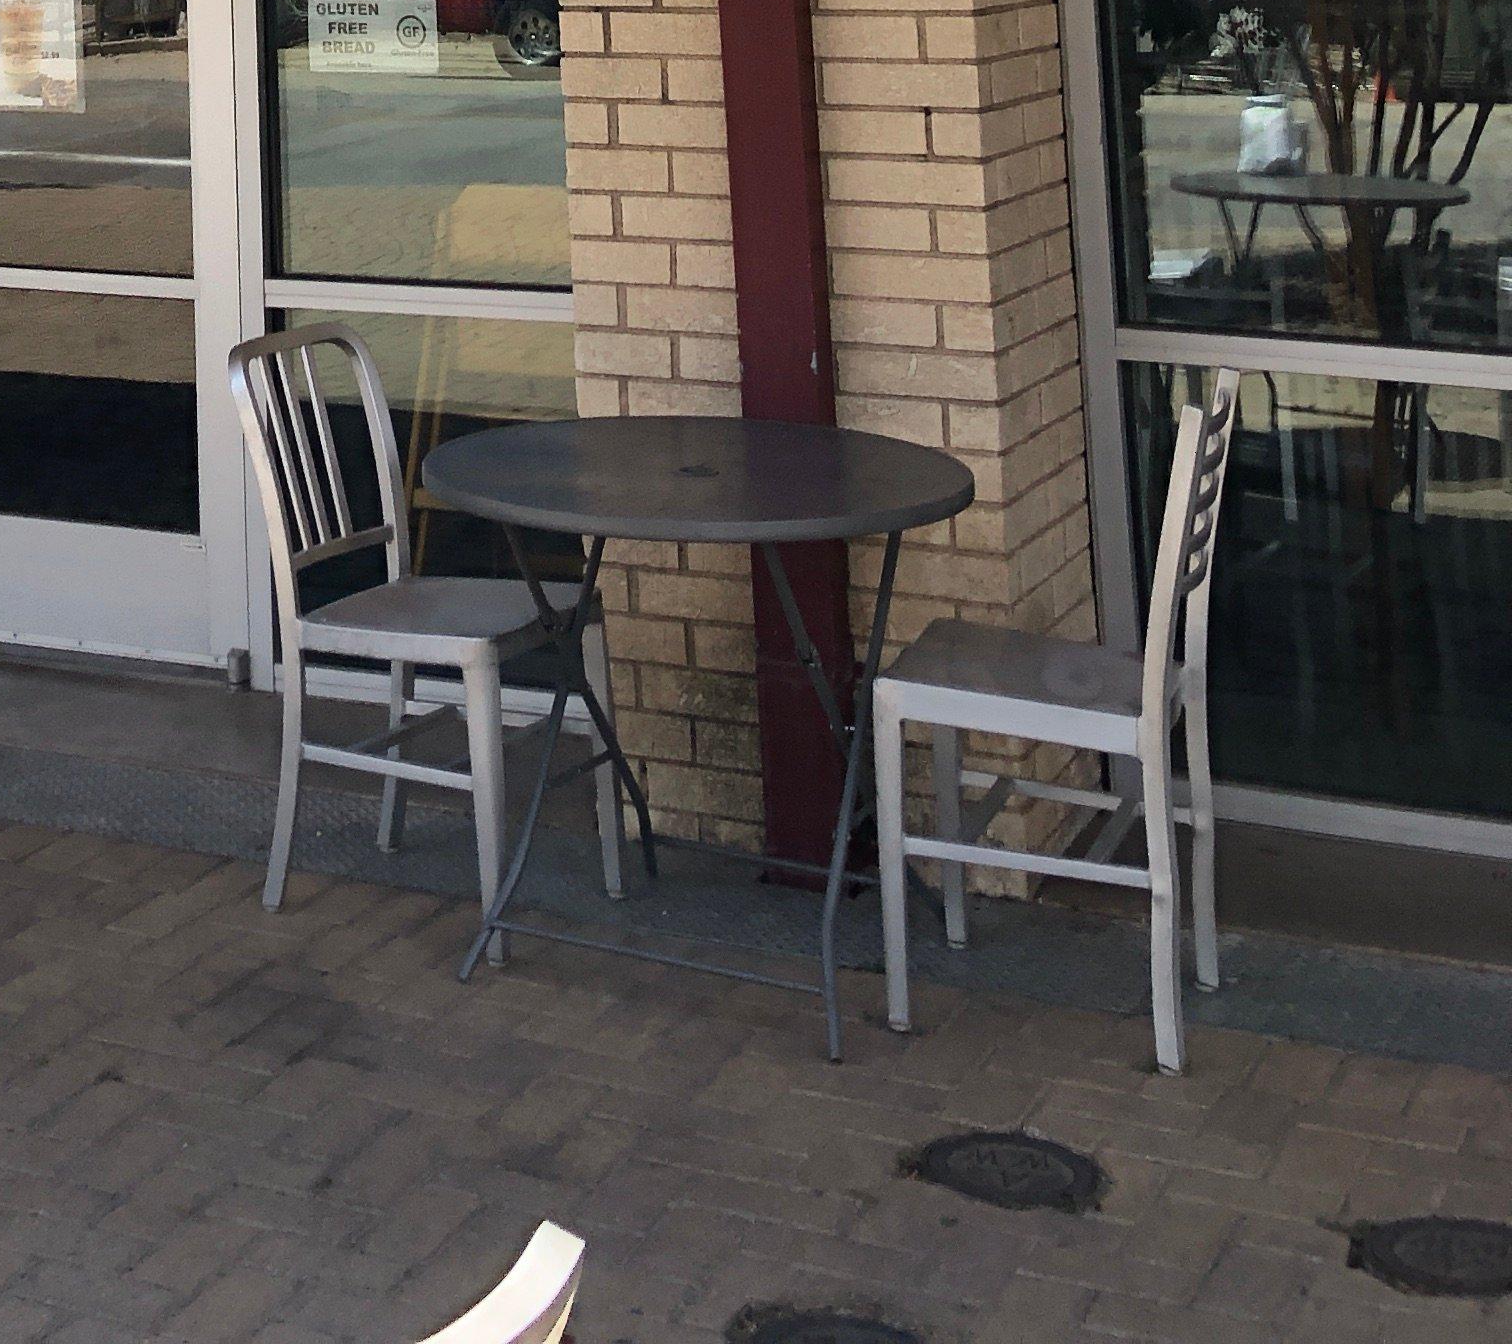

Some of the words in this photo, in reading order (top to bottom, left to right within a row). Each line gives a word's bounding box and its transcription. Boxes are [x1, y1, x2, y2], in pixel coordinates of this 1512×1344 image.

[316, 2, 379, 16] GLUTEN
[328, 21, 368, 35] FREE
[402, 26, 420, 38] GF
[322, 40, 376, 54] BREAD
